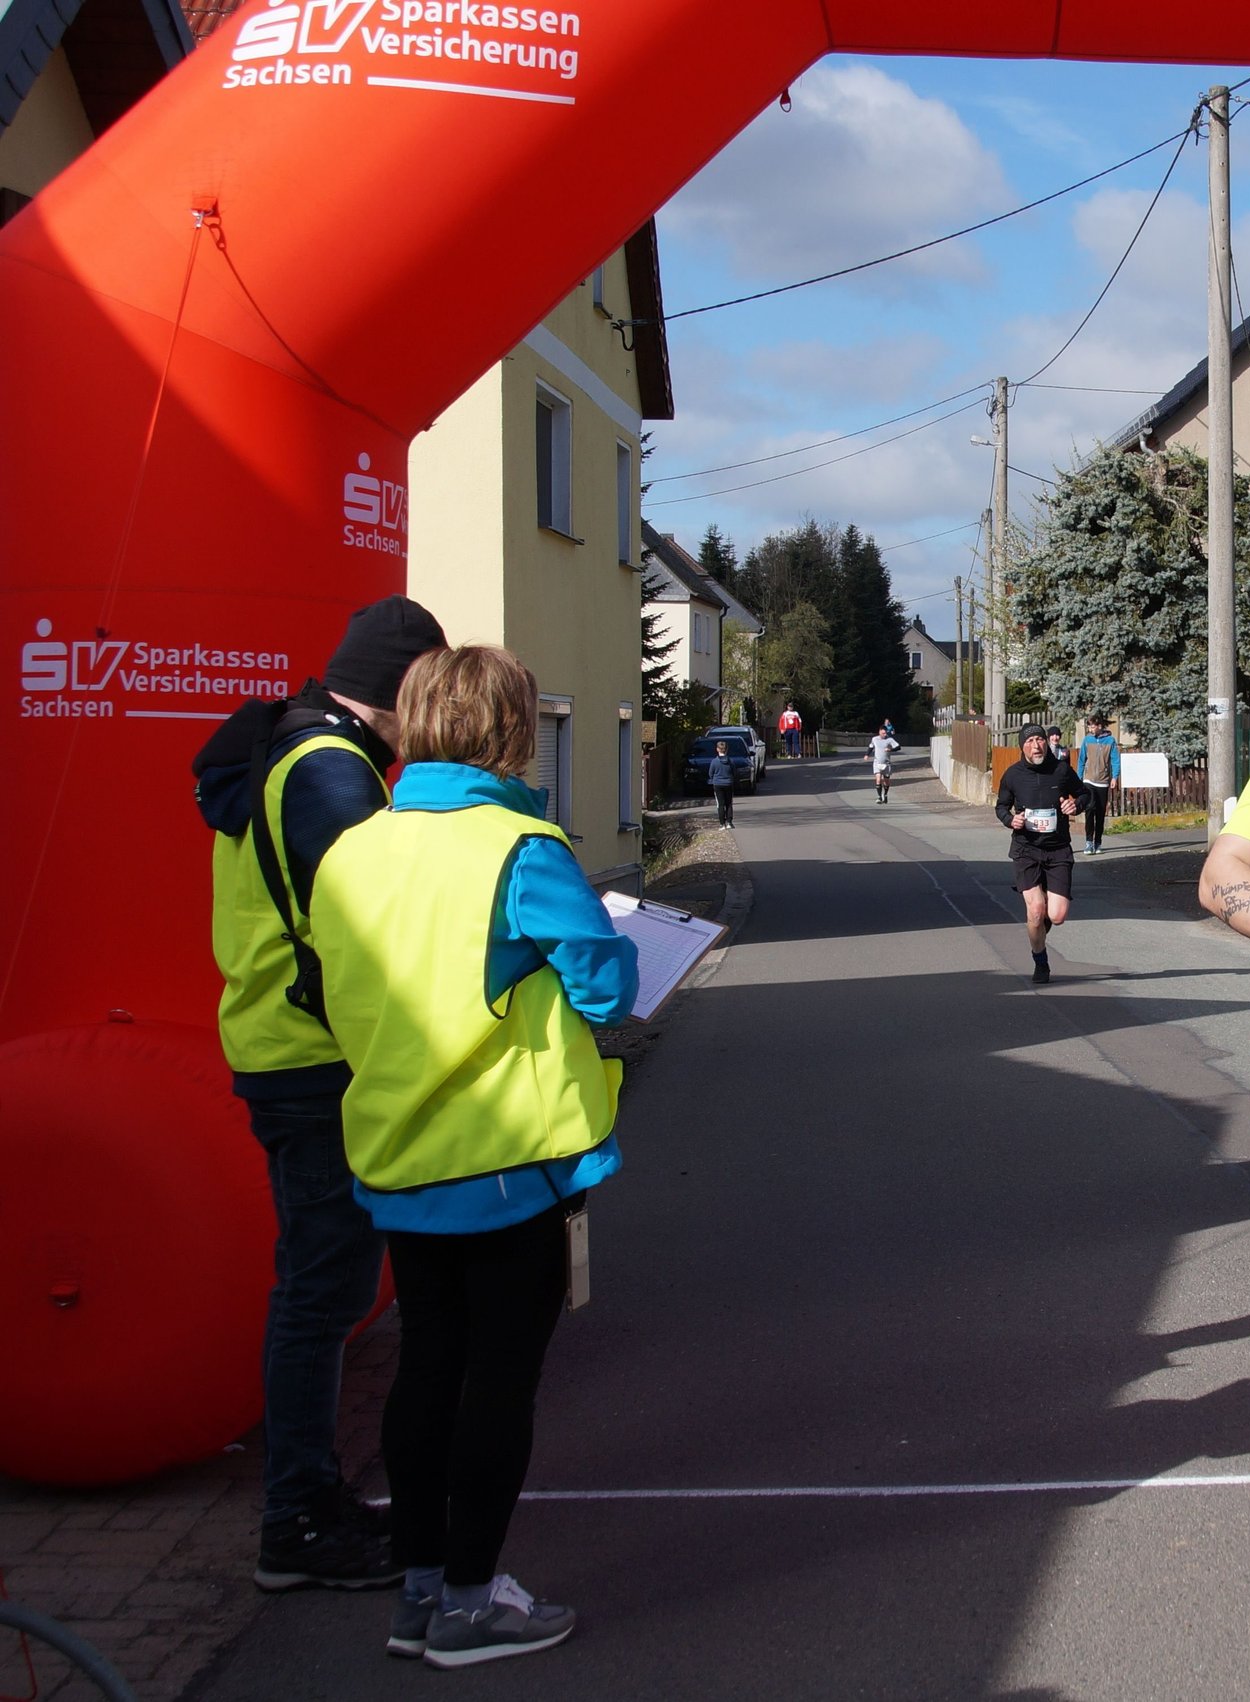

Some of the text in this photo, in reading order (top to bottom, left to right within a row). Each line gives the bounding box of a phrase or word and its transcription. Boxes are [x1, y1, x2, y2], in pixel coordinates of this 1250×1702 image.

[381, 0, 580, 37] Sparkassen
[361, 27, 578, 80] Versicherung
[222, 60, 351, 89] Sachsen
[343, 524, 400, 556] Sachsen
[133, 642, 289, 671] Sparkassen
[119, 669, 288, 701] Versicherung
[20, 696, 113, 718] Sachsen
